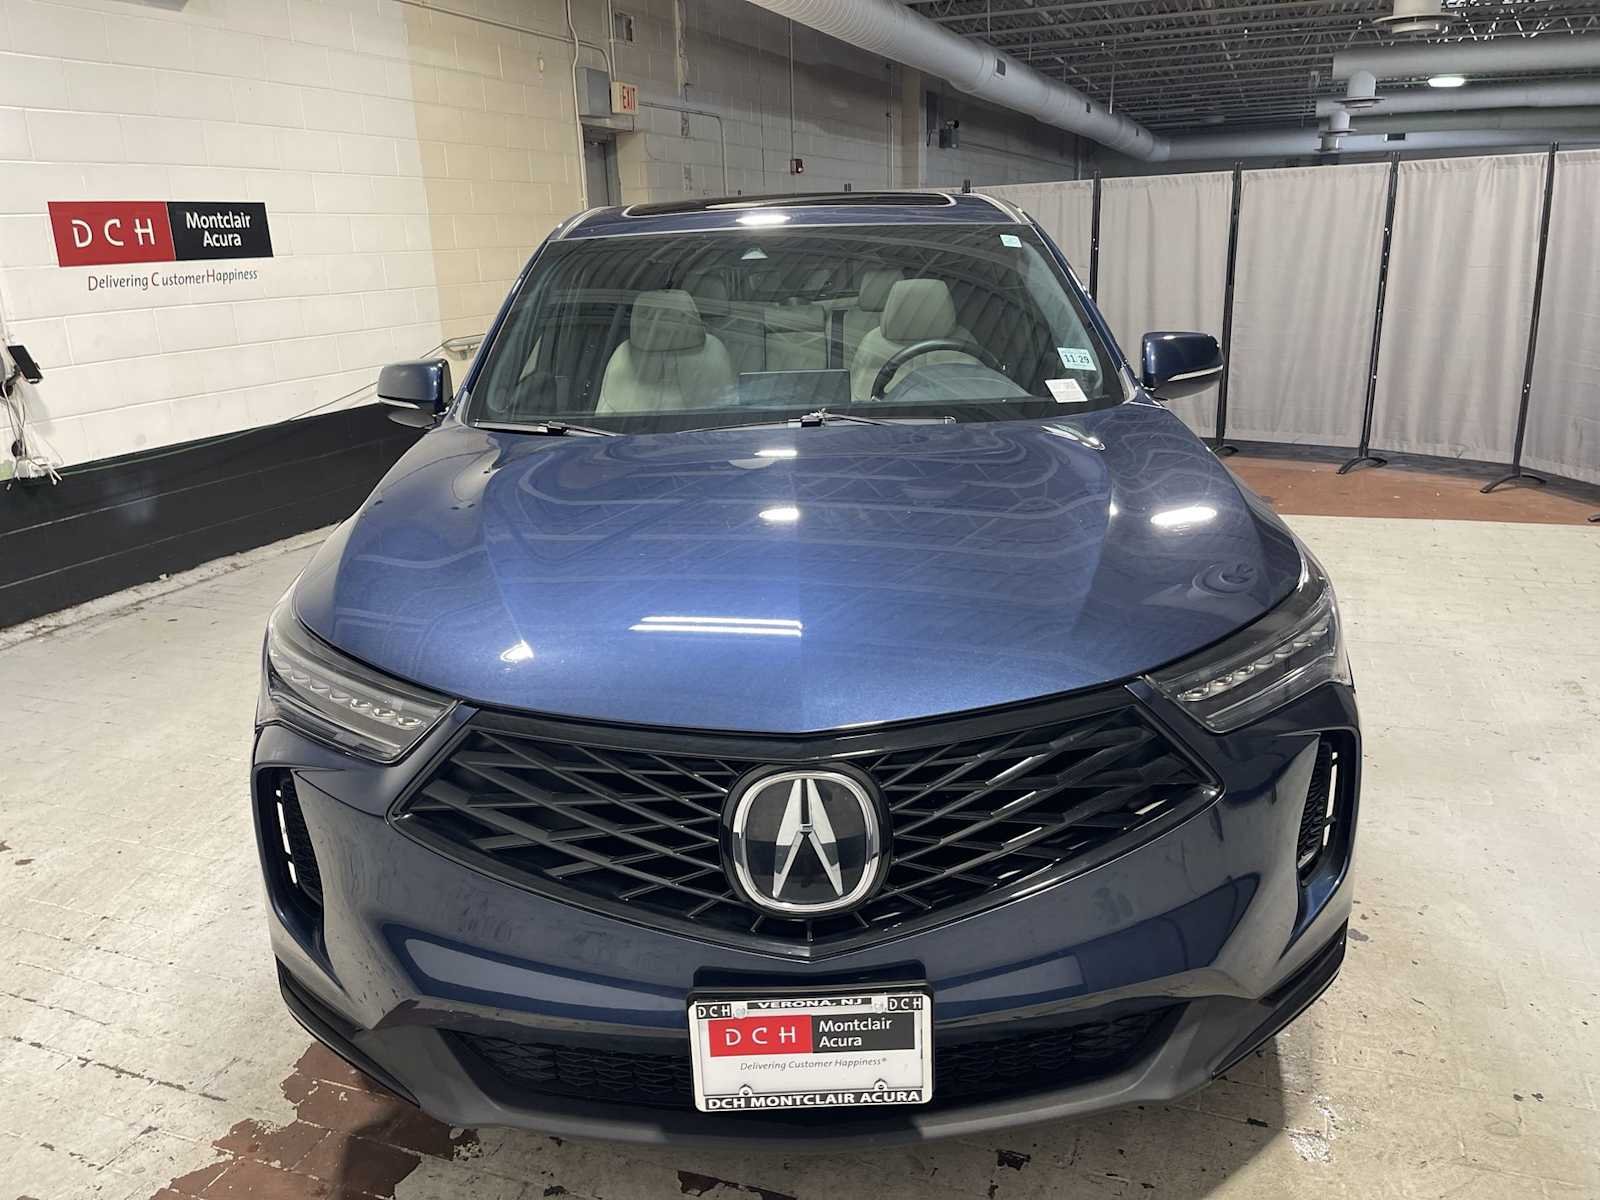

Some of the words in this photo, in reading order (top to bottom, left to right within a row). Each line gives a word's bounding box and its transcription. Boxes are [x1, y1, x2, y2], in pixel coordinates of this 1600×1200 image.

[622, 86, 636, 112] EXIT
[185, 211, 251, 230] Montclair
[203, 231, 243, 248] Acura
[88, 274, 149, 292] Delivering
[841, 998, 862, 1006] NJ
[819, 1017, 892, 1033] Montclair
[819, 1036, 862, 1048] Acura
[740, 1060, 786, 1072] Delivering
[788, 1058, 832, 1069] Customer
[707, 1098, 745, 1110] DCH
[750, 1093, 855, 1108] MONTCLAIR
[859, 1090, 921, 1103] ACURA
